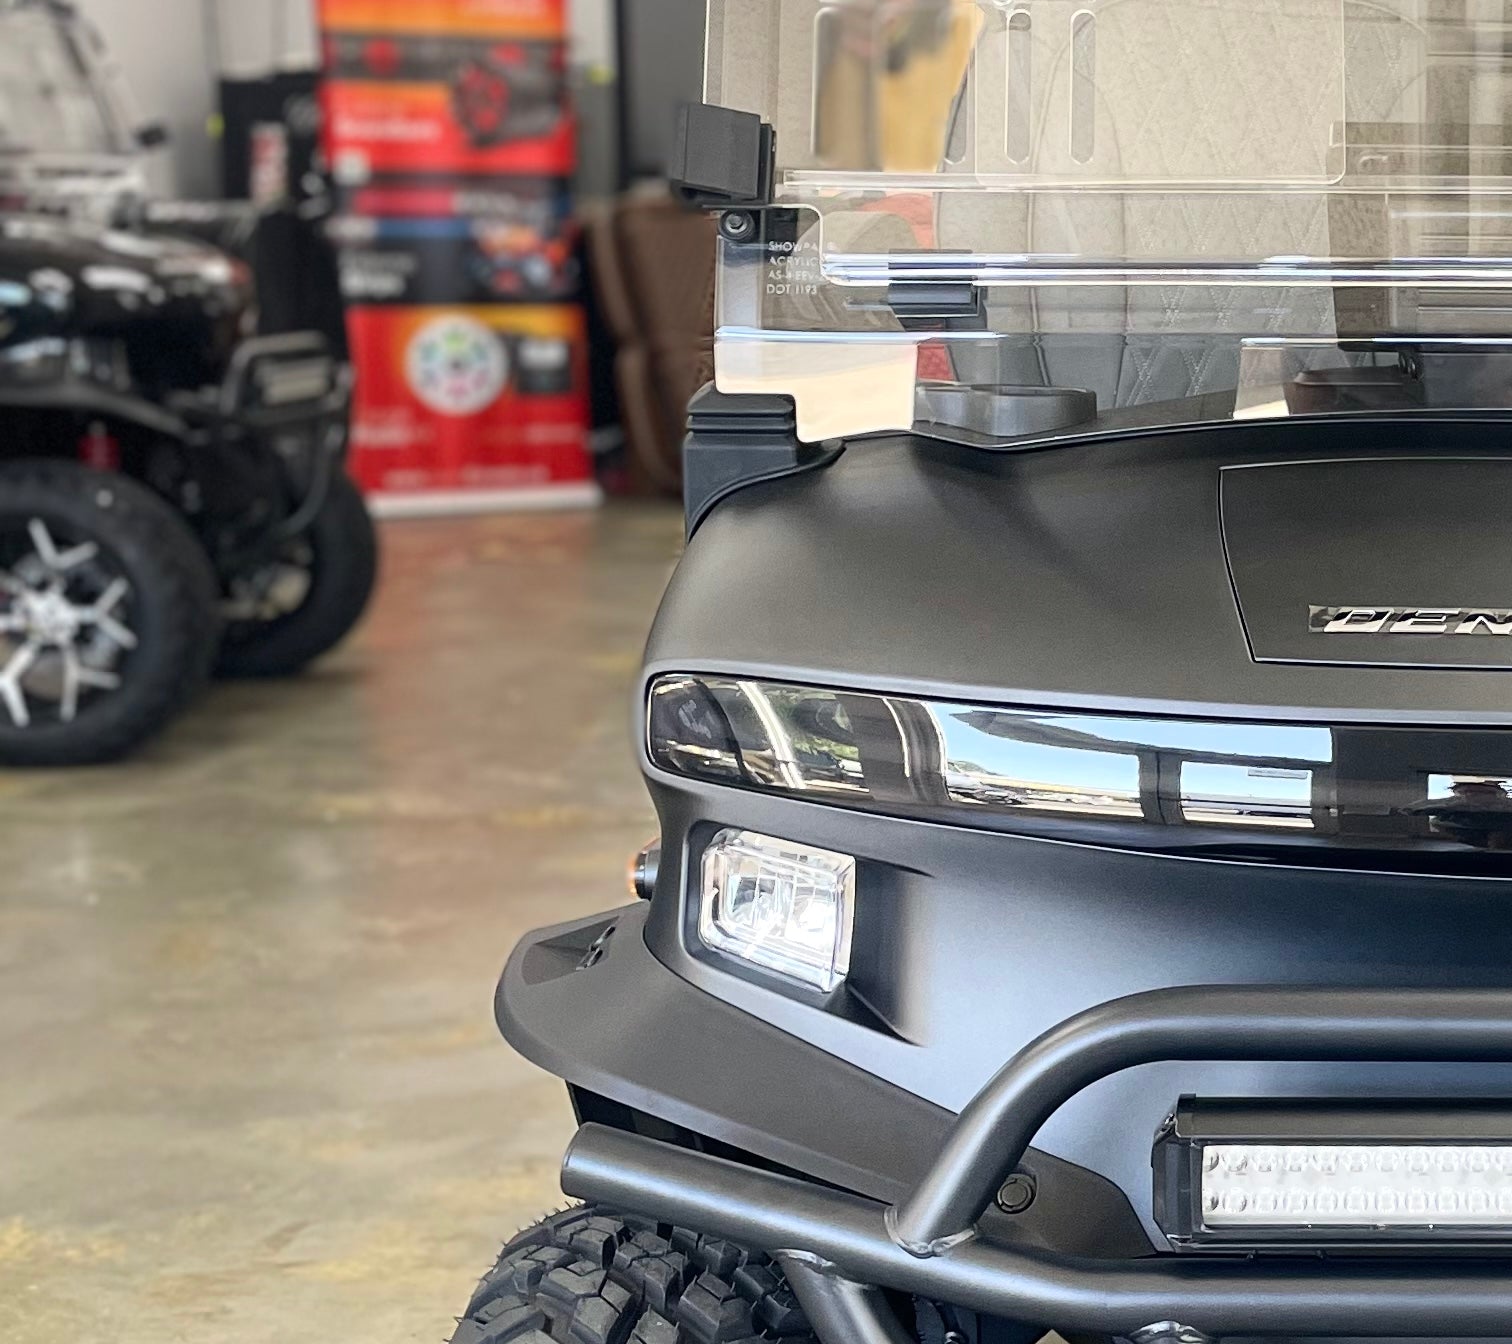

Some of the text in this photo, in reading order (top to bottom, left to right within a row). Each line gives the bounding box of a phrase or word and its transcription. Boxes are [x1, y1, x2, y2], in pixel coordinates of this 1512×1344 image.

[769, 256, 819, 267] ACRYLIC
[766, 283, 818, 295] DOT 1193
